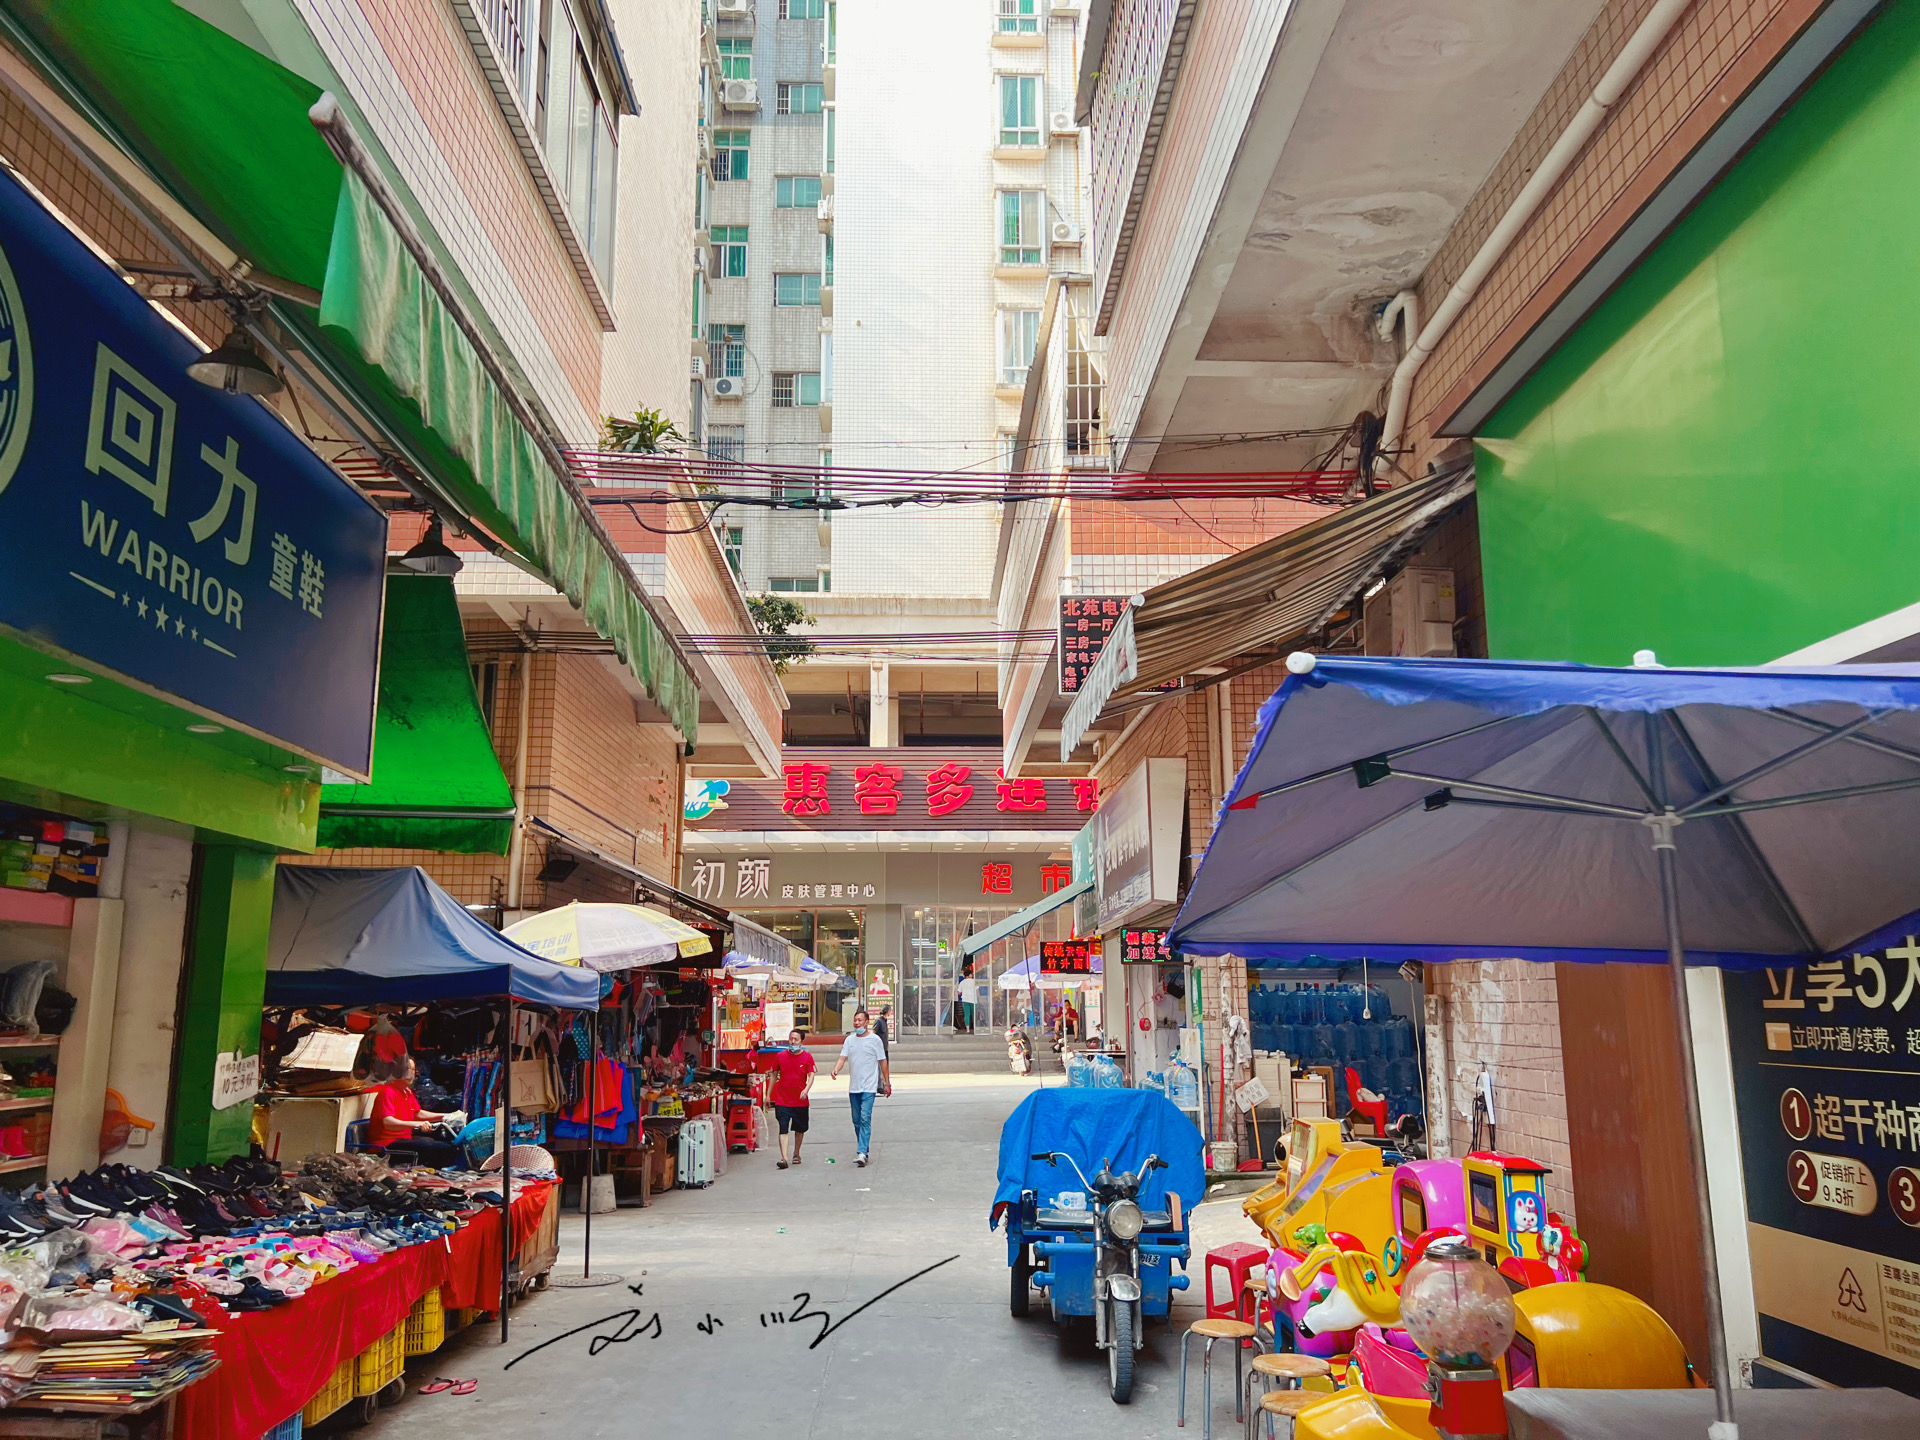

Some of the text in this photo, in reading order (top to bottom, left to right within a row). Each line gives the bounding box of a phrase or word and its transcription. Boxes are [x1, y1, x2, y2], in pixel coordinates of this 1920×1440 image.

[85, 341, 258, 566] 回力
[81, 500, 244, 630] WARRIOR
[269, 531, 325, 619] 童鞋
[1065, 618, 1114, 631] 一房一厅
[691, 858, 876, 900] 初颜 皮肤管理中心
[982, 862, 1071, 894] 超市
[1126, 946, 1171, 960] 加煤气
[1820, 1161, 1868, 1186] 促销折上
[1822, 1185, 1854, 1208] 9.5折
